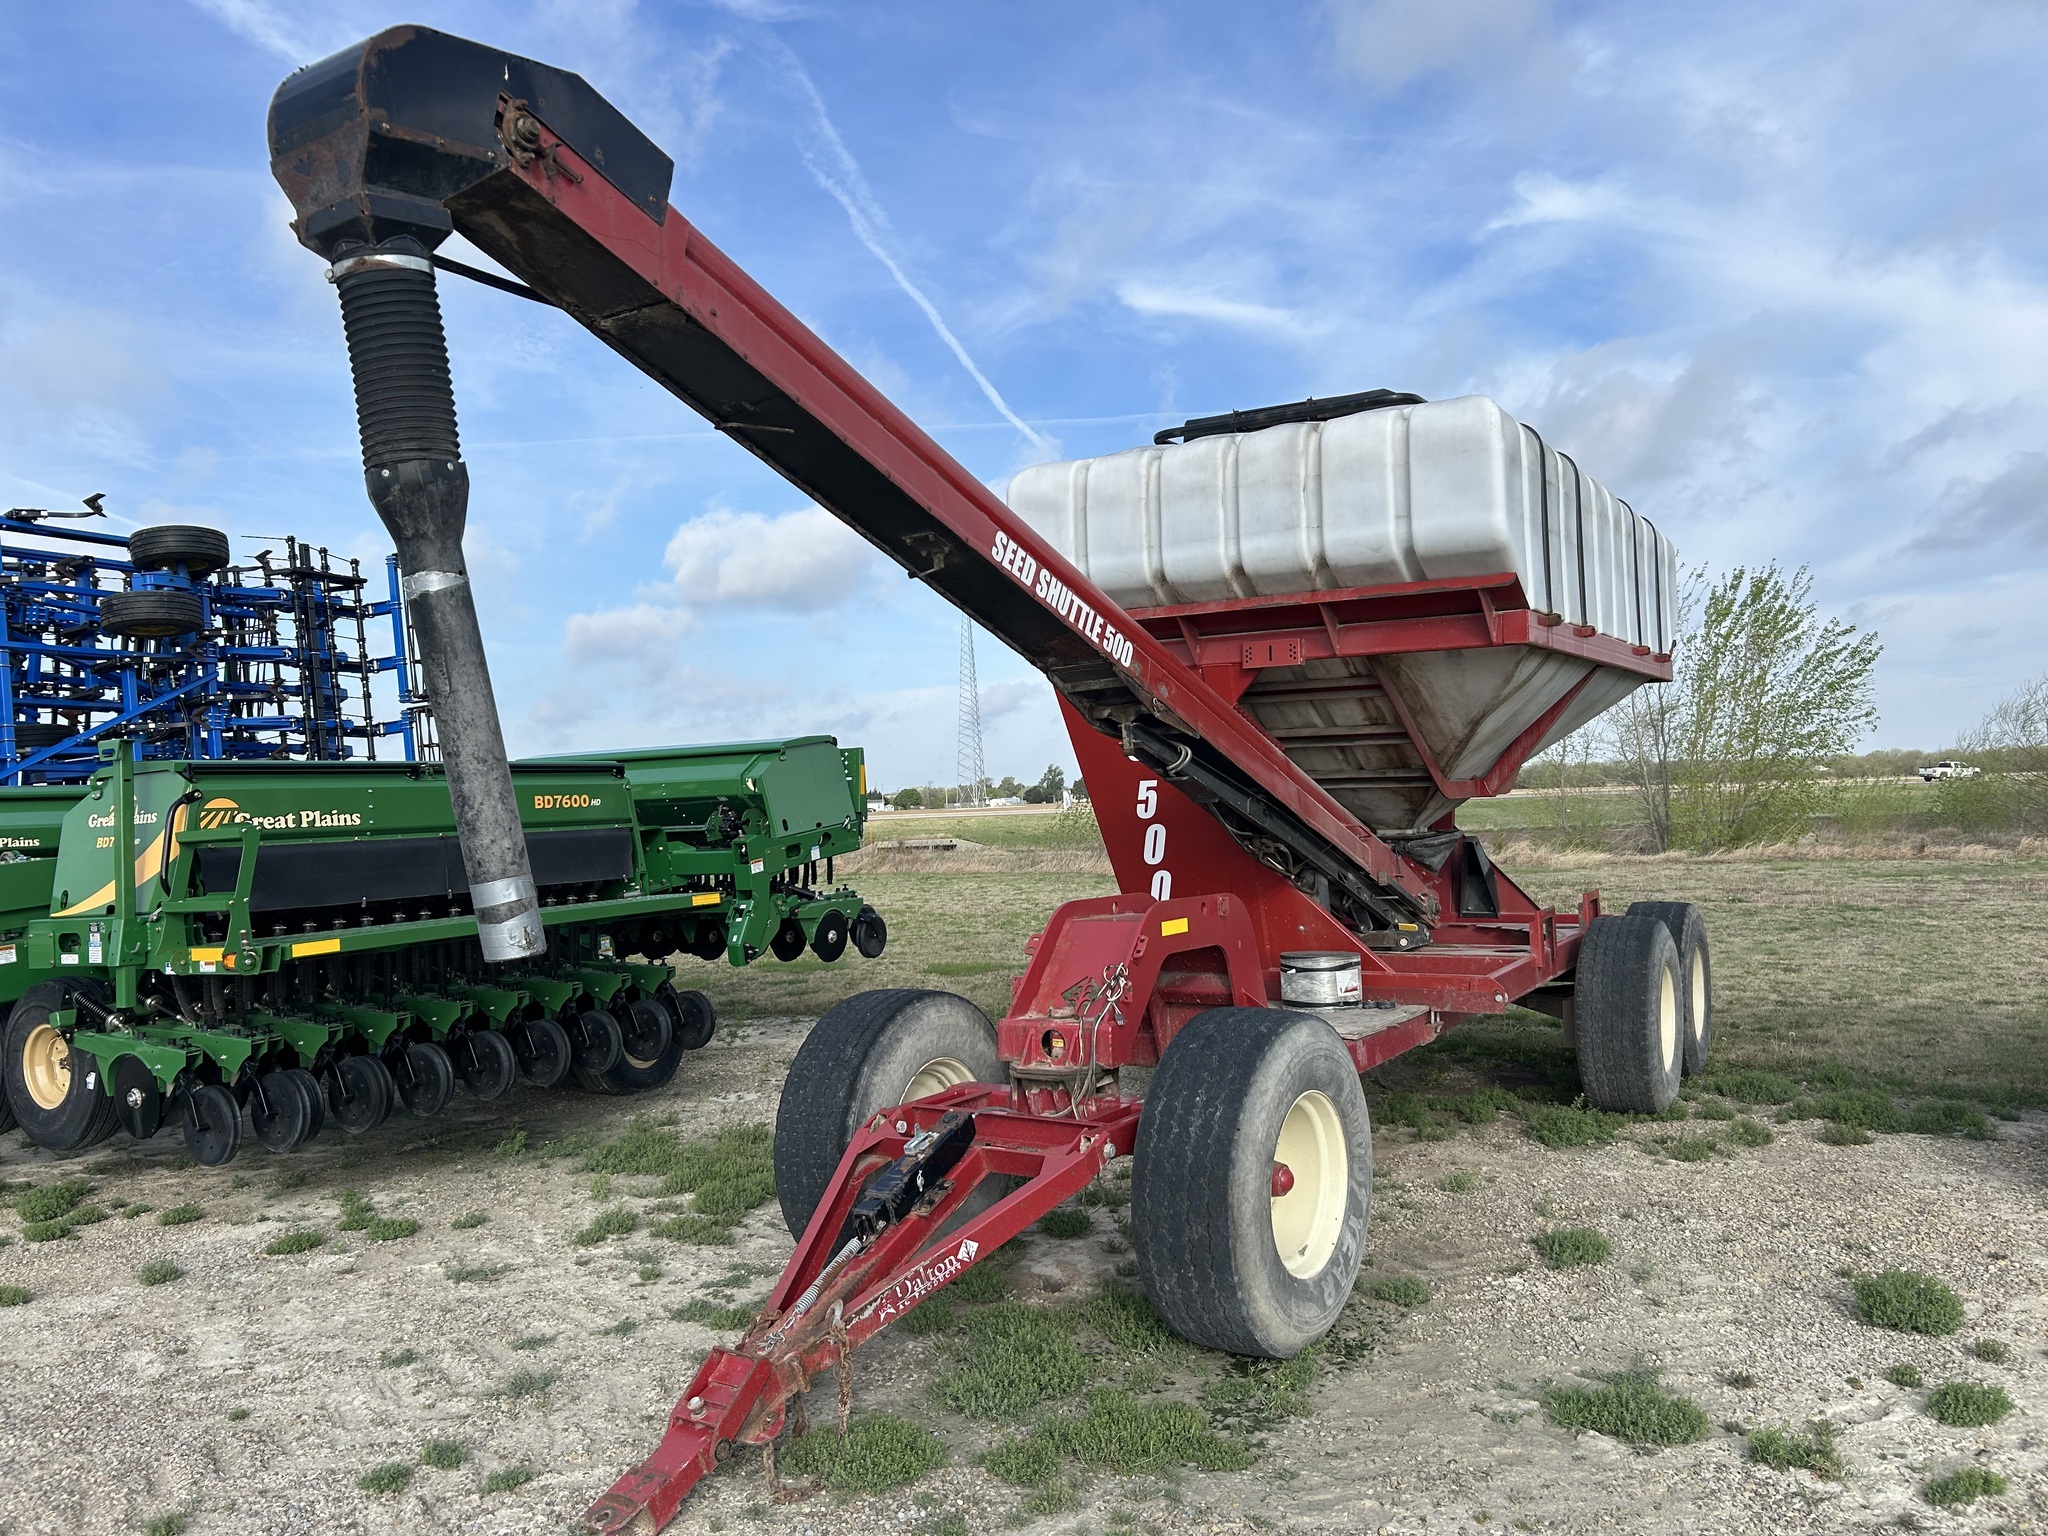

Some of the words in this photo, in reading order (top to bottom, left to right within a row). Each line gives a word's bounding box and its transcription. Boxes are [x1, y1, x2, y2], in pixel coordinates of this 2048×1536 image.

[992, 530, 1036, 587] SEED
[1035, 568, 1105, 644] SHUTTLE
[1103, 629, 1134, 668] 500
[534, 794, 589, 809] BD7600
[590, 798, 602, 806] HD
[88, 813, 115, 828] Grea
[234, 812, 296, 829] Great
[299, 809, 361, 828] Plains
[0, 837, 40, 848] Plains
[895, 1254, 959, 1299] Dalton
